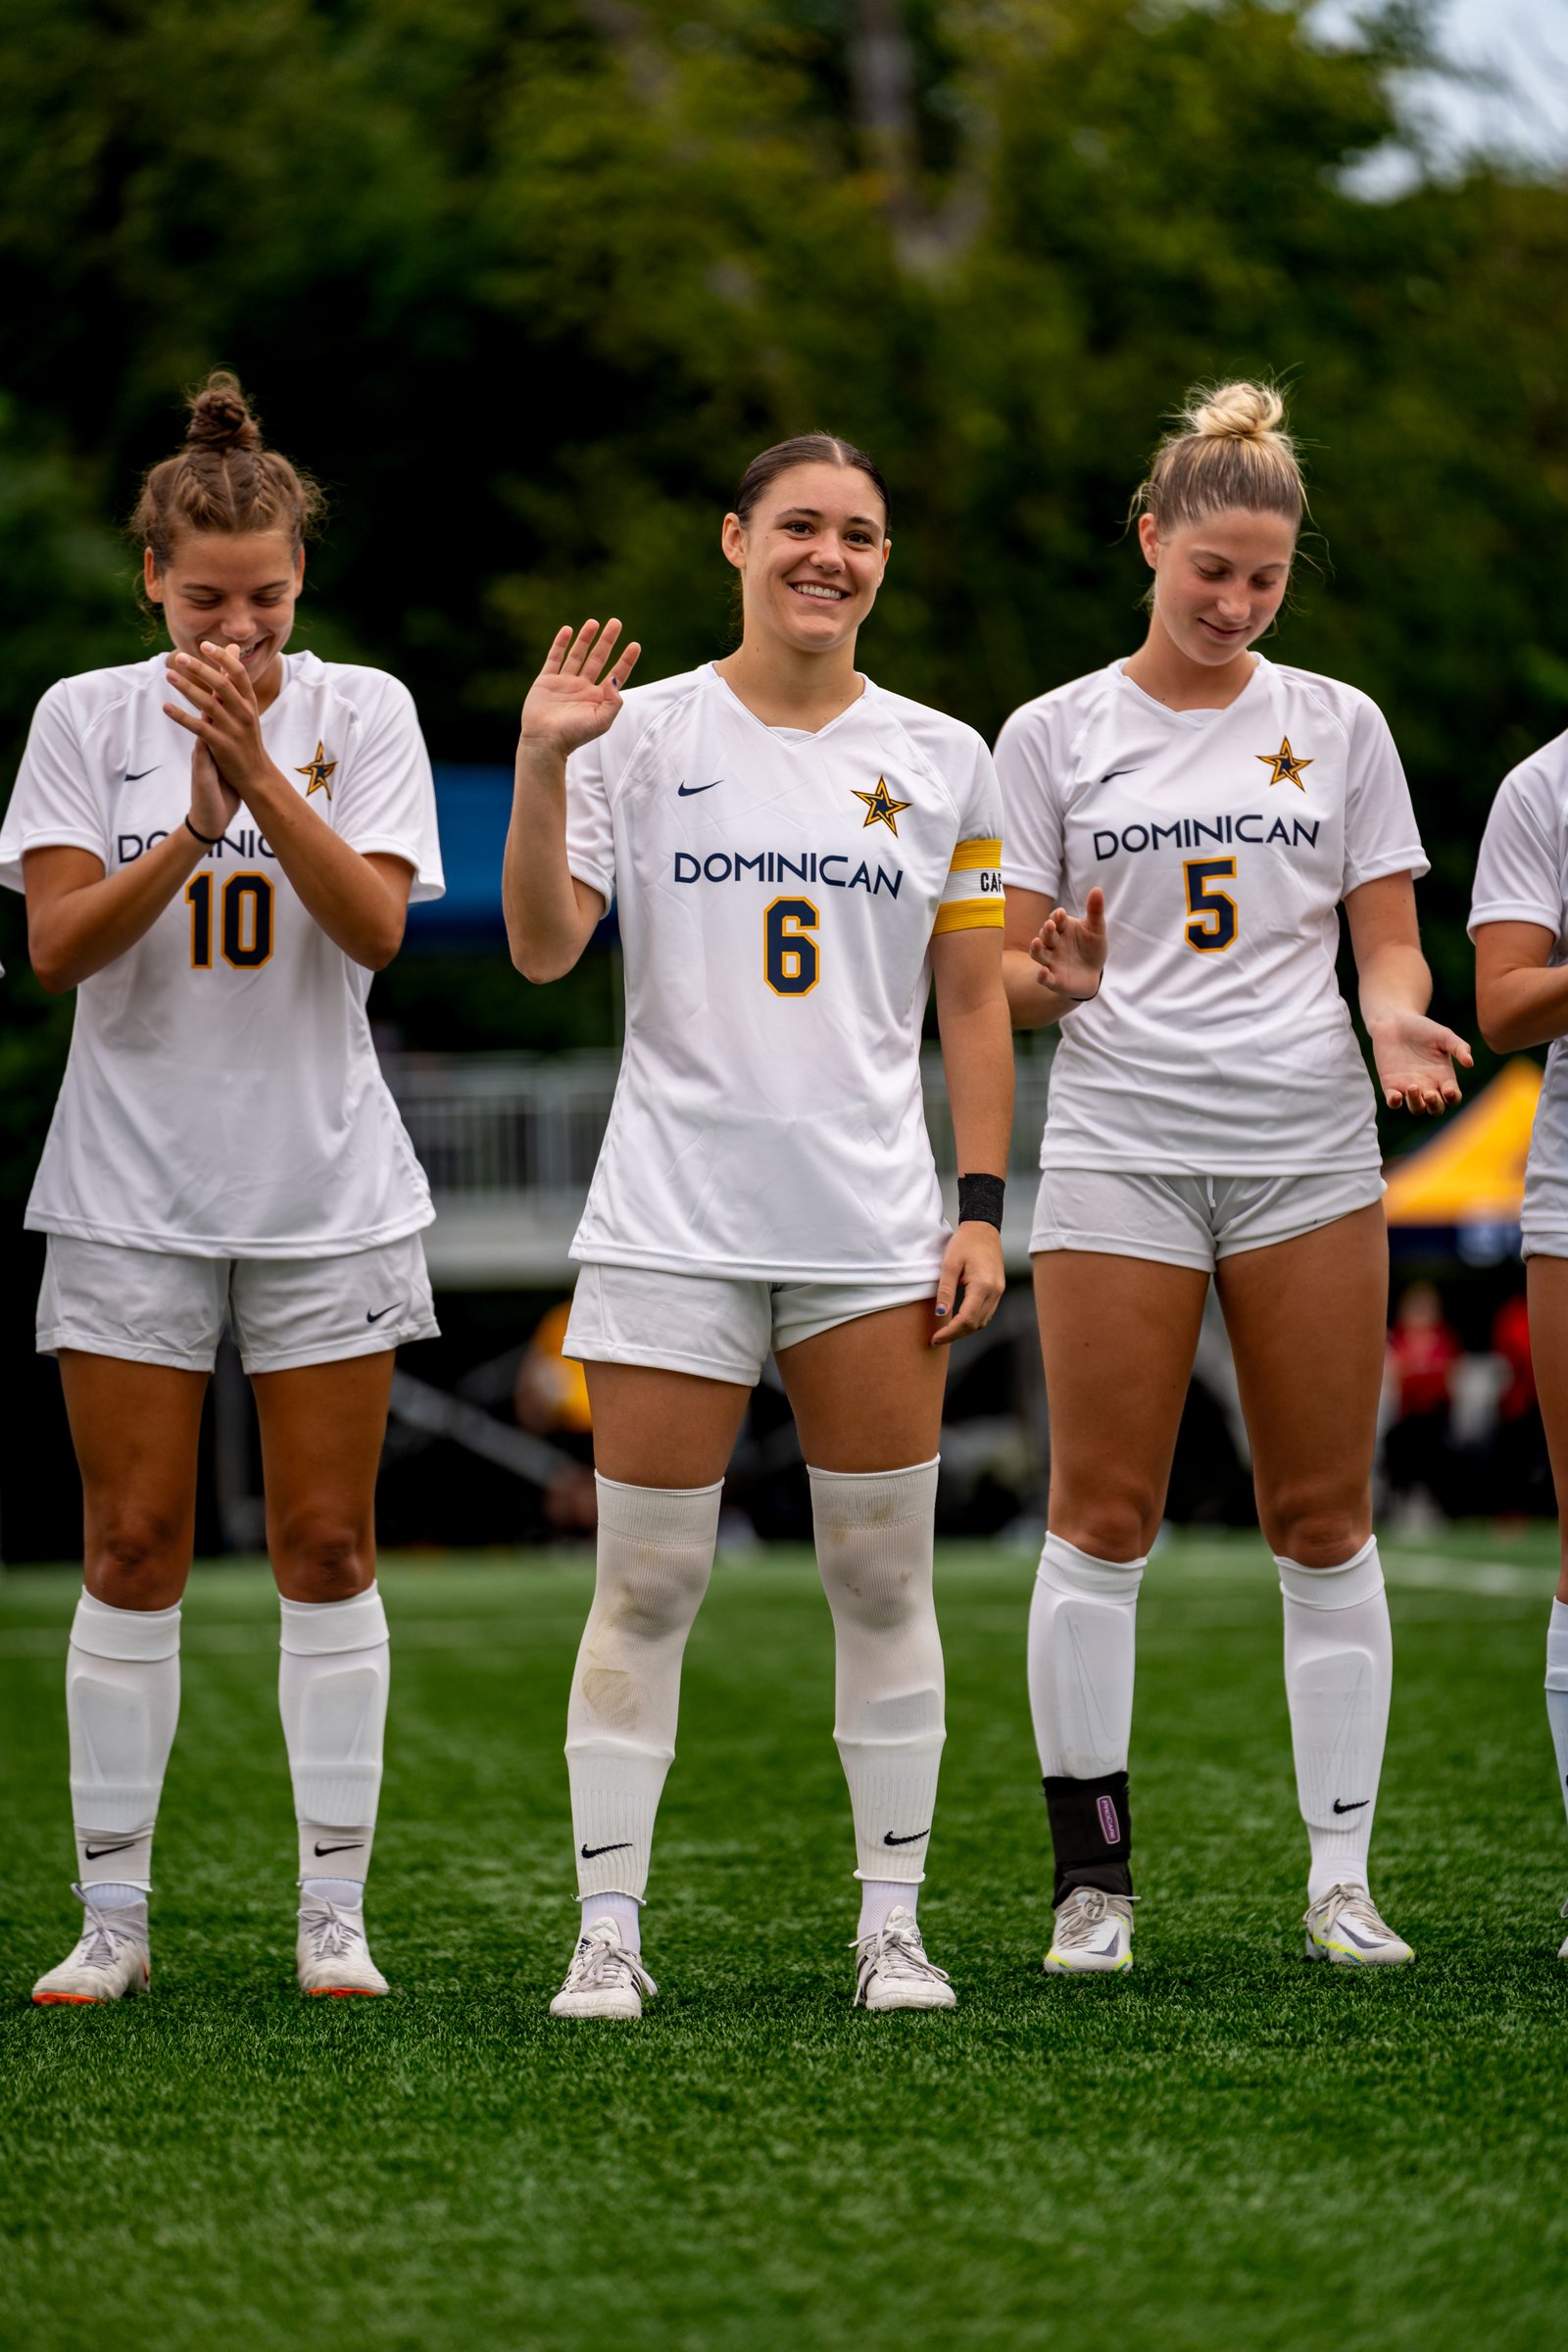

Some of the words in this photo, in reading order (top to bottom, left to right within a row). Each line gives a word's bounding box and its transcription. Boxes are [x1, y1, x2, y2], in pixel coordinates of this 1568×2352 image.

[674, 852, 904, 900] DOMINICAN
[1094, 814, 1320, 860] DOMINICAN
[185, 871, 274, 970] 10
[763, 896, 820, 997] 6
[1183, 856, 1238, 953] 5
